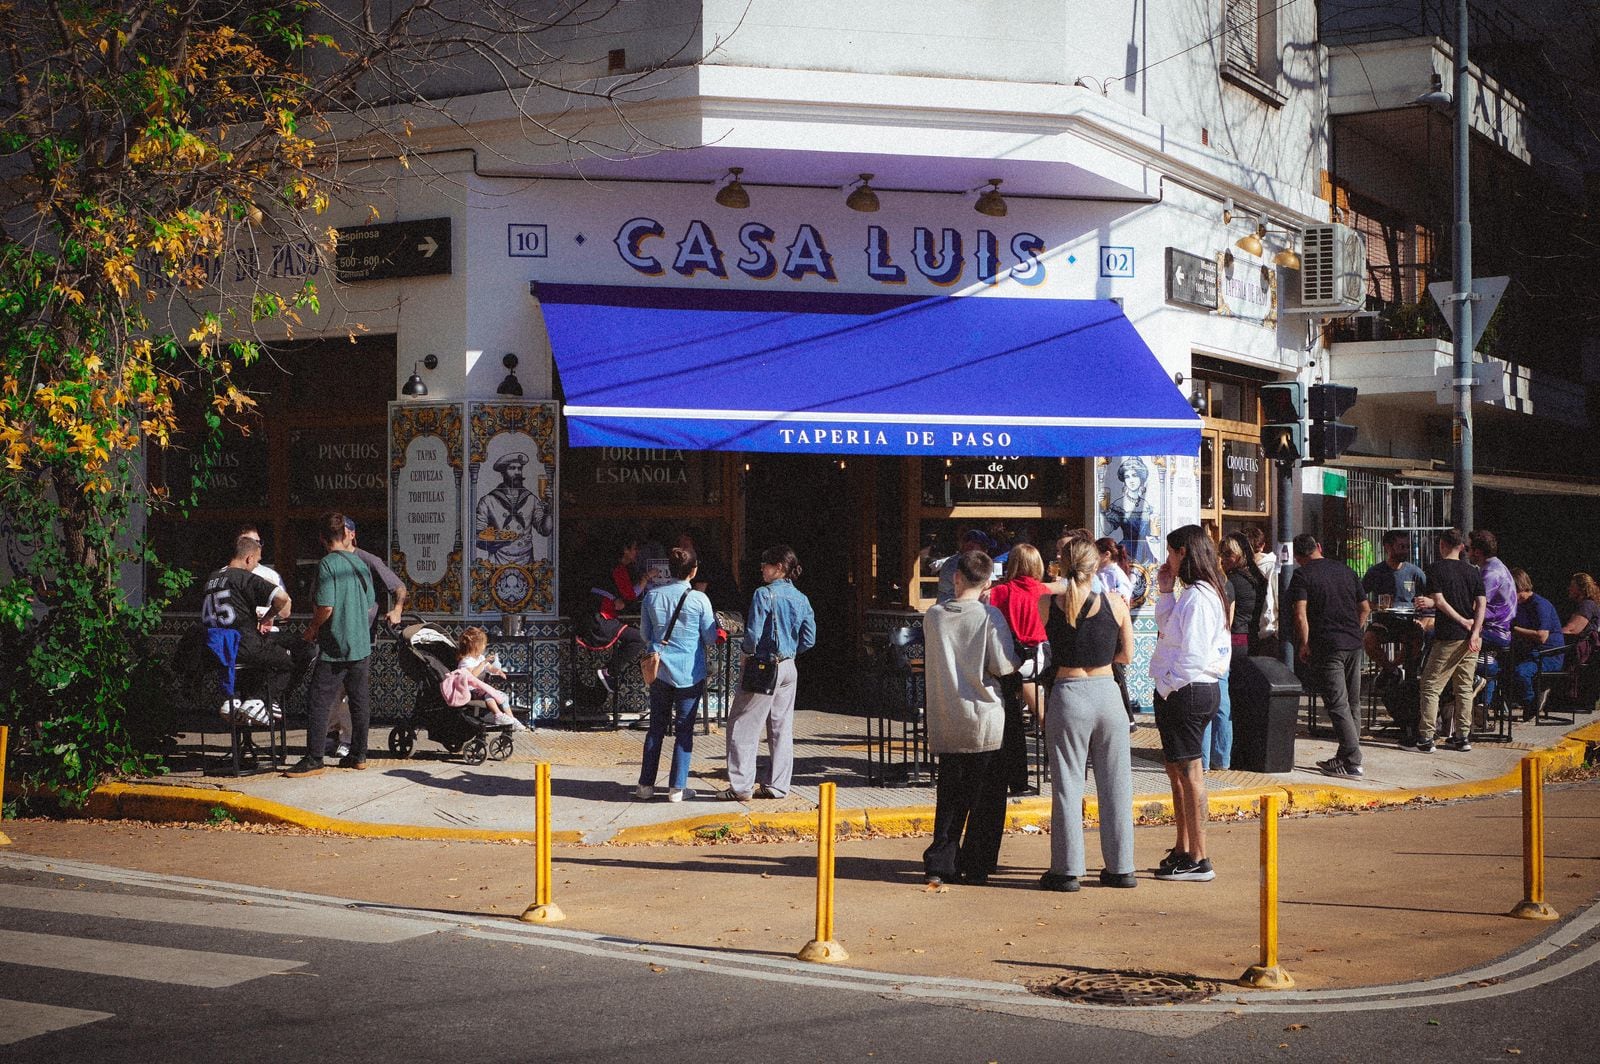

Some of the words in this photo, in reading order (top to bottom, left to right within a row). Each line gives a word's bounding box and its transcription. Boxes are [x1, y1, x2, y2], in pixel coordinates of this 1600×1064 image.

[340, 230, 380, 242] Espinosa
[516, 232, 539, 251] 10
[613, 217, 838, 282] CASA
[864, 225, 1047, 289] LUIS
[340, 257, 356, 268] 500
[363, 255, 380, 266] 600
[1106, 253, 1128, 271] 02
[779, 429, 888, 445] TAPERIA
[906, 431, 935, 446] DE
[952, 431, 1012, 447] PASO
[319, 443, 380, 460] PINCHOS
[417, 449, 437, 461] TAPAS
[601, 447, 684, 462] TORTILLA
[987, 462, 1004, 472] de
[1227, 455, 1259, 473] CROQUETAS
[410, 470, 443, 482] CERVEZAS
[596, 463, 687, 484] ESPAÑOLA
[314, 473, 385, 491] MARISCOS
[964, 474, 1029, 490] VERANO
[408, 491, 445, 503] TORTILLAS
[1233, 483, 1253, 498] OLIVAS
[408, 512, 445, 524] CROQUETAS
[413, 533, 440, 545] VERMUT
[422, 546, 431, 558] DE
[416, 560, 437, 572] GRIFO
[202, 589, 236, 627] 45
